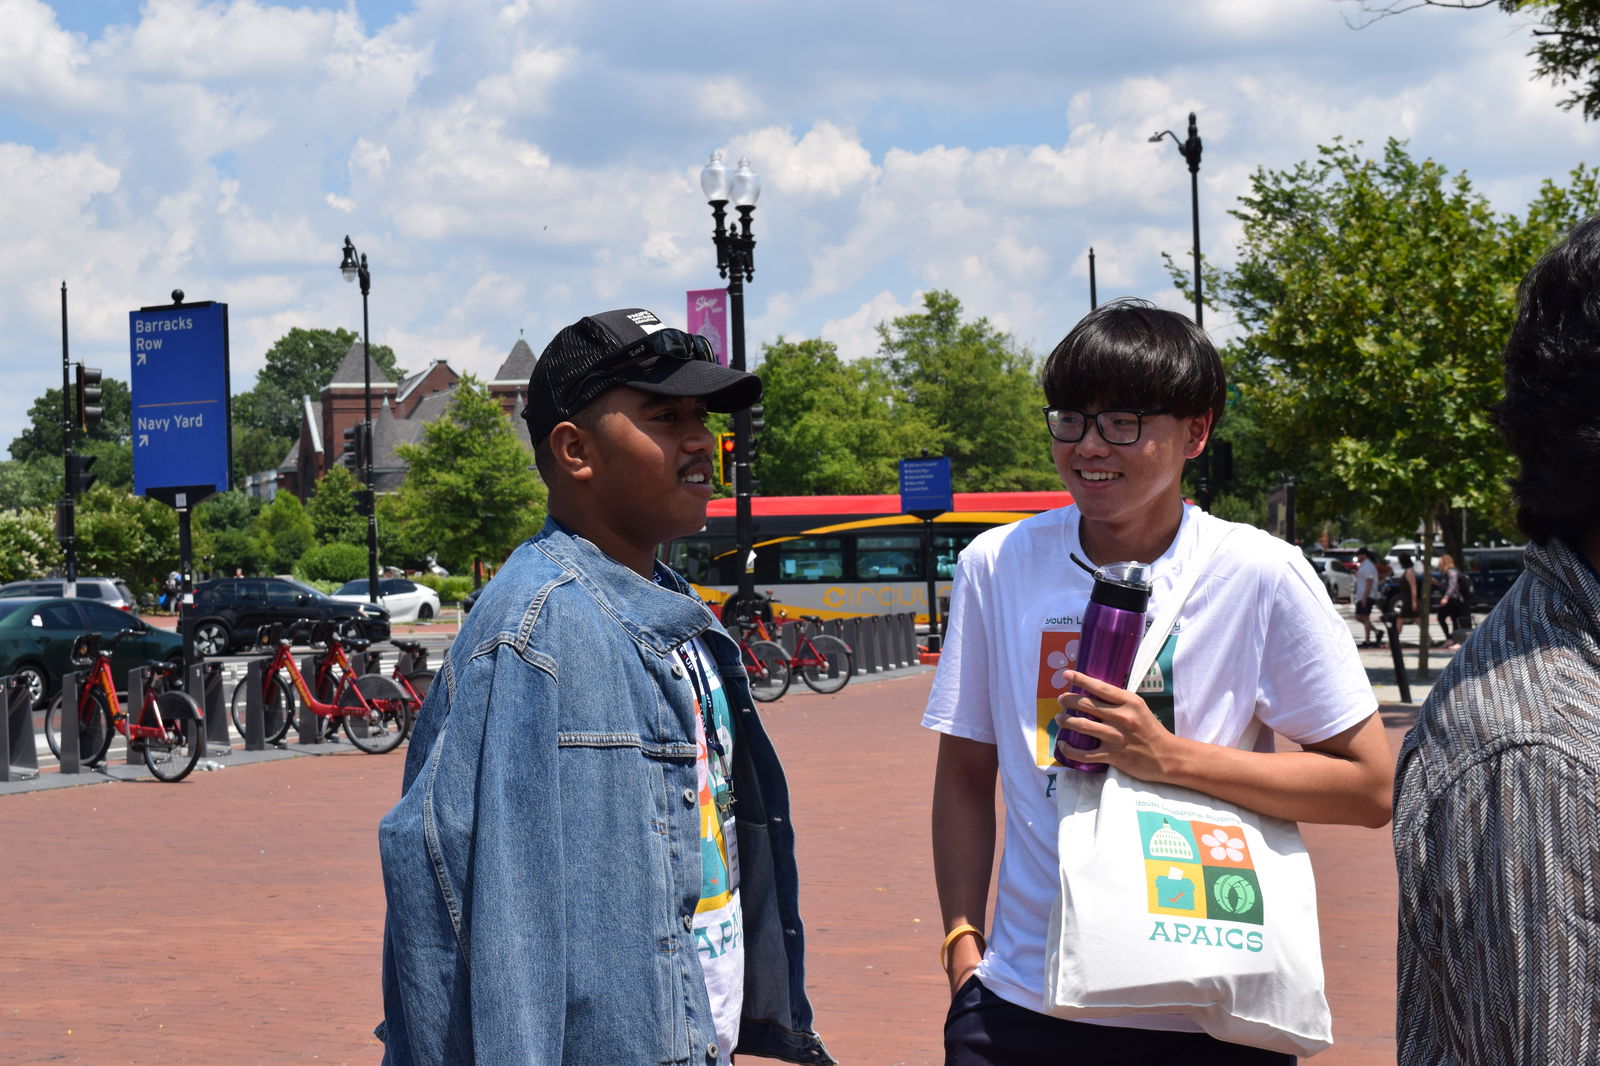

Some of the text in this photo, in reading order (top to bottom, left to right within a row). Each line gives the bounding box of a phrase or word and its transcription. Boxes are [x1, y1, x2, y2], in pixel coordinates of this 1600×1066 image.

[135, 317, 193, 333] Barracks
[136, 338, 163, 351] Row
[138, 413, 203, 432] Navy Yard
[1148, 921, 1263, 952] APAICS
